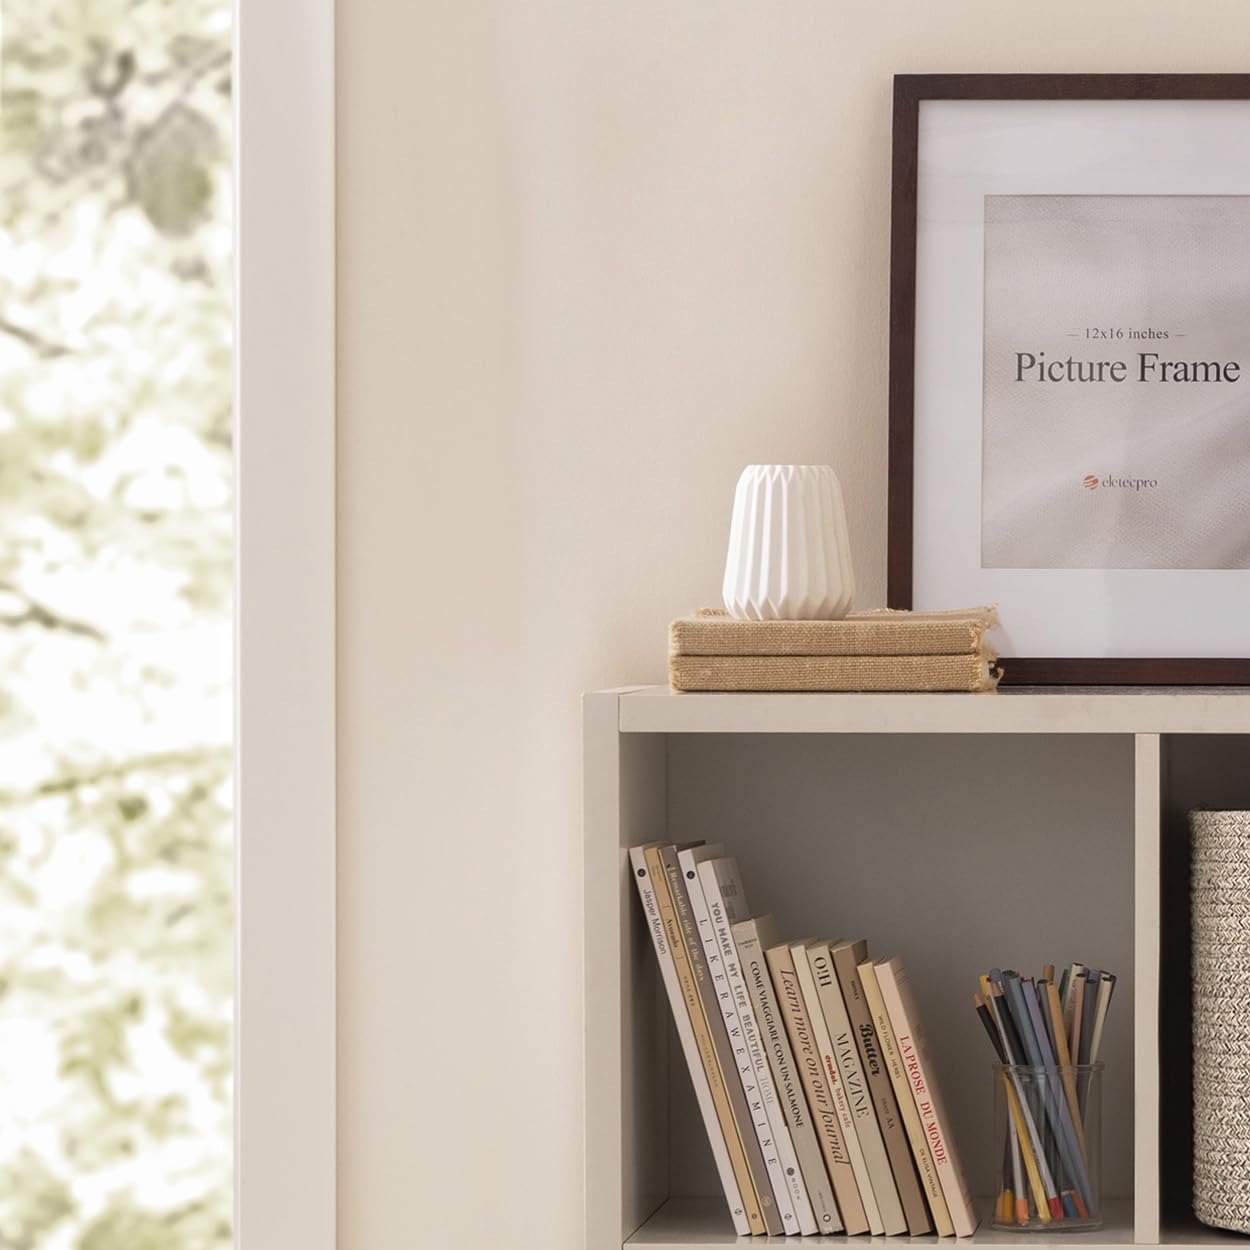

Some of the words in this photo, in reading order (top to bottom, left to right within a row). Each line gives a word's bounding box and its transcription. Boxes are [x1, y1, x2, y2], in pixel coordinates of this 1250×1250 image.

[1085, 327, 1124, 340] 12x16
[1129, 327, 1169, 340] inches
[1014, 351, 1128, 383] Picture
[1137, 352, 1241, 383] Frame
[670, 872, 688, 916] Remarkable
[643, 889, 656, 916] Jasper
[652, 917, 666, 955] Morrison
[682, 919, 693, 934] ride
[687, 937, 696, 946] of
[690, 948, 699, 960] the
[711, 903, 722, 923] YOU
[718, 928, 732, 956] MAKE
[727, 964, 738, 978] MY
[734, 985, 746, 1007] LIFE
[743, 1015, 765, 1072] BEAUTIFUL
[780, 969, 801, 1013] Learn
[749, 961, 764, 989] COME
[759, 990, 778, 1041] VIAGGIARE
[773, 1043, 785, 1065] CON
[780, 1067, 790, 1081] UN
[785, 1083, 803, 1128] SALMONE
[794, 1015, 813, 1054] more
[859, 1024, 880, 1077] Butter
[878, 1016, 886, 1030] WILD
[883, 1031, 893, 1055] FLOWER
[891, 1059, 900, 1078] HERBS
[900, 1036, 912, 1053] LA
[806, 1057, 820, 1077] on
[835, 1033, 869, 1118] MAGAZINE
[907, 1054, 926, 1095] PROSE
[812, 1080, 827, 1107] our
[835, 1088, 845, 1111] bakery
[842, 1113, 851, 1128] cafe
[920, 1101, 933, 1120] DU
[822, 1108, 849, 1165] Journal
[926, 1122, 946, 1165] MONDE
[922, 1157, 930, 1173] ELISA
[927, 1173, 938, 1198] VINTAGE
